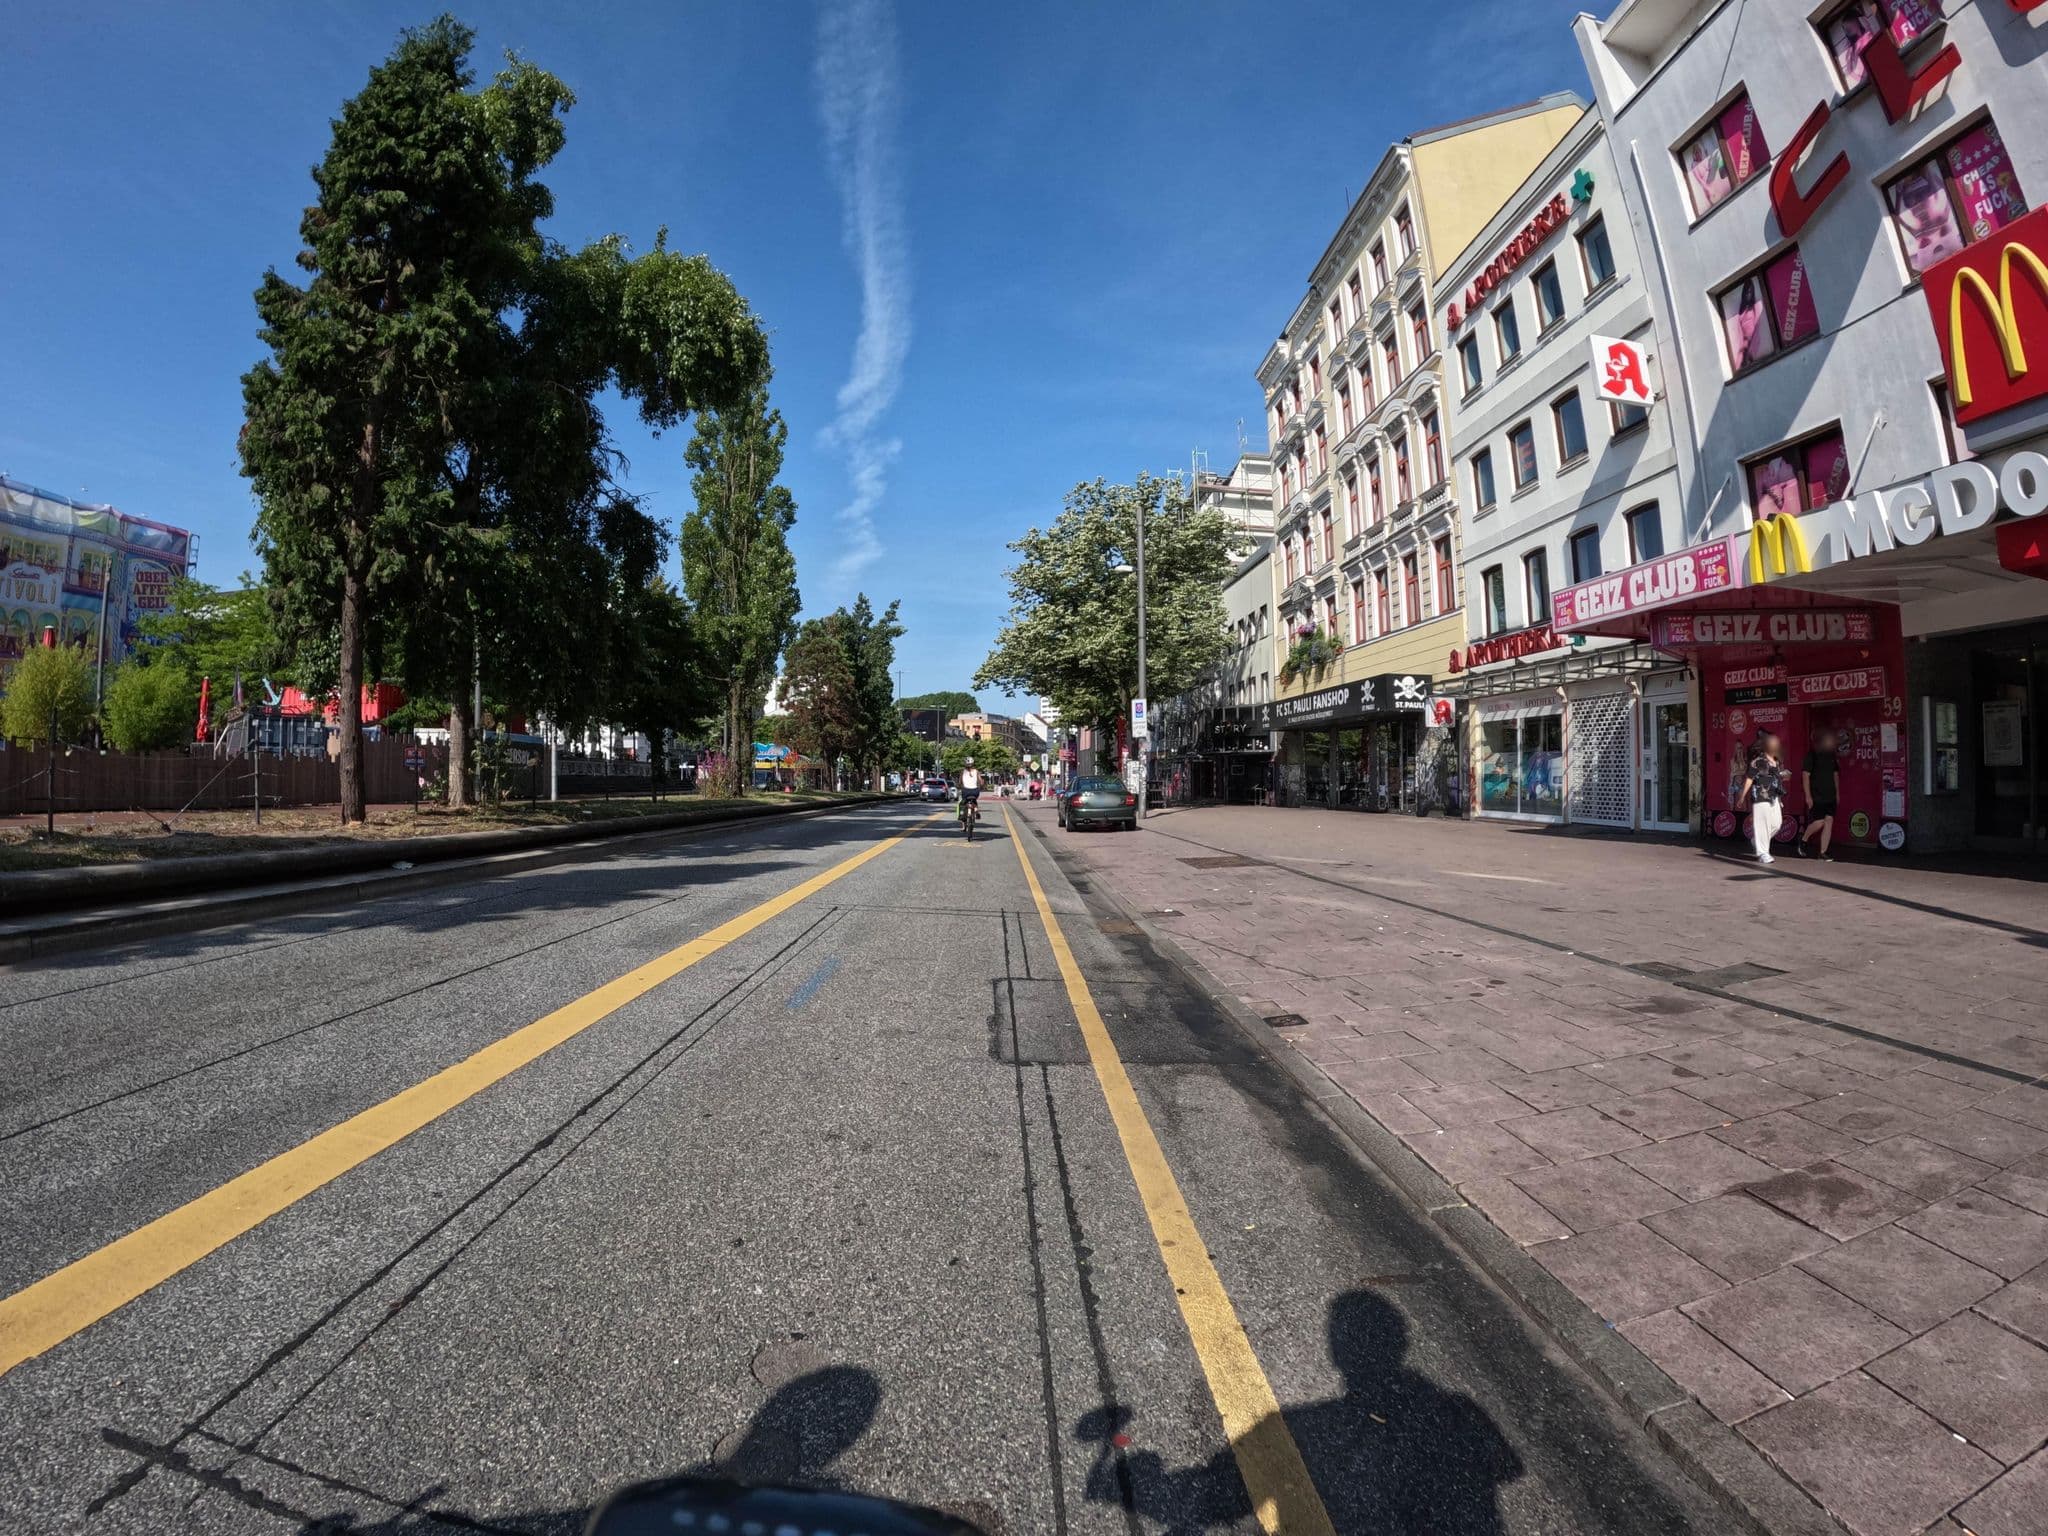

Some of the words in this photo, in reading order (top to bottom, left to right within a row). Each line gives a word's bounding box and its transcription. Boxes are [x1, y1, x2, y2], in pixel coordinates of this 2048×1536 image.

[1963, 155, 2000, 185] CHEAP
[1979, 174, 1996, 196] AS
[1974, 188, 2012, 219] FUCK
[1465, 192, 1571, 315] APOTHEKE
[1574, 576, 1625, 620] GEIZ
[1630, 556, 1697, 606] CLUB
[1693, 615, 1763, 642] GEIZ
[1770, 614, 1847, 641] CLUB
[1465, 630, 1565, 669] APOTHEKE
[1725, 670, 1747, 684] GEIZ
[1749, 667, 1775, 682] CLUB
[1802, 676, 1831, 693] GEIZ
[1833, 672, 1868, 690] CLUB
[1276, 704, 1283, 717] FC
[1284, 702, 1292, 716] ST.
[1293, 696, 1312, 713] PAULI
[1312, 688, 1350, 709] FANSHOP
[1883, 696, 1901, 716] 59
[1214, 722, 1247, 734] STRY
[1712, 712, 1725, 728] 59
[1861, 735, 1872, 746] AS
[1856, 748, 1879, 760] FUCK
